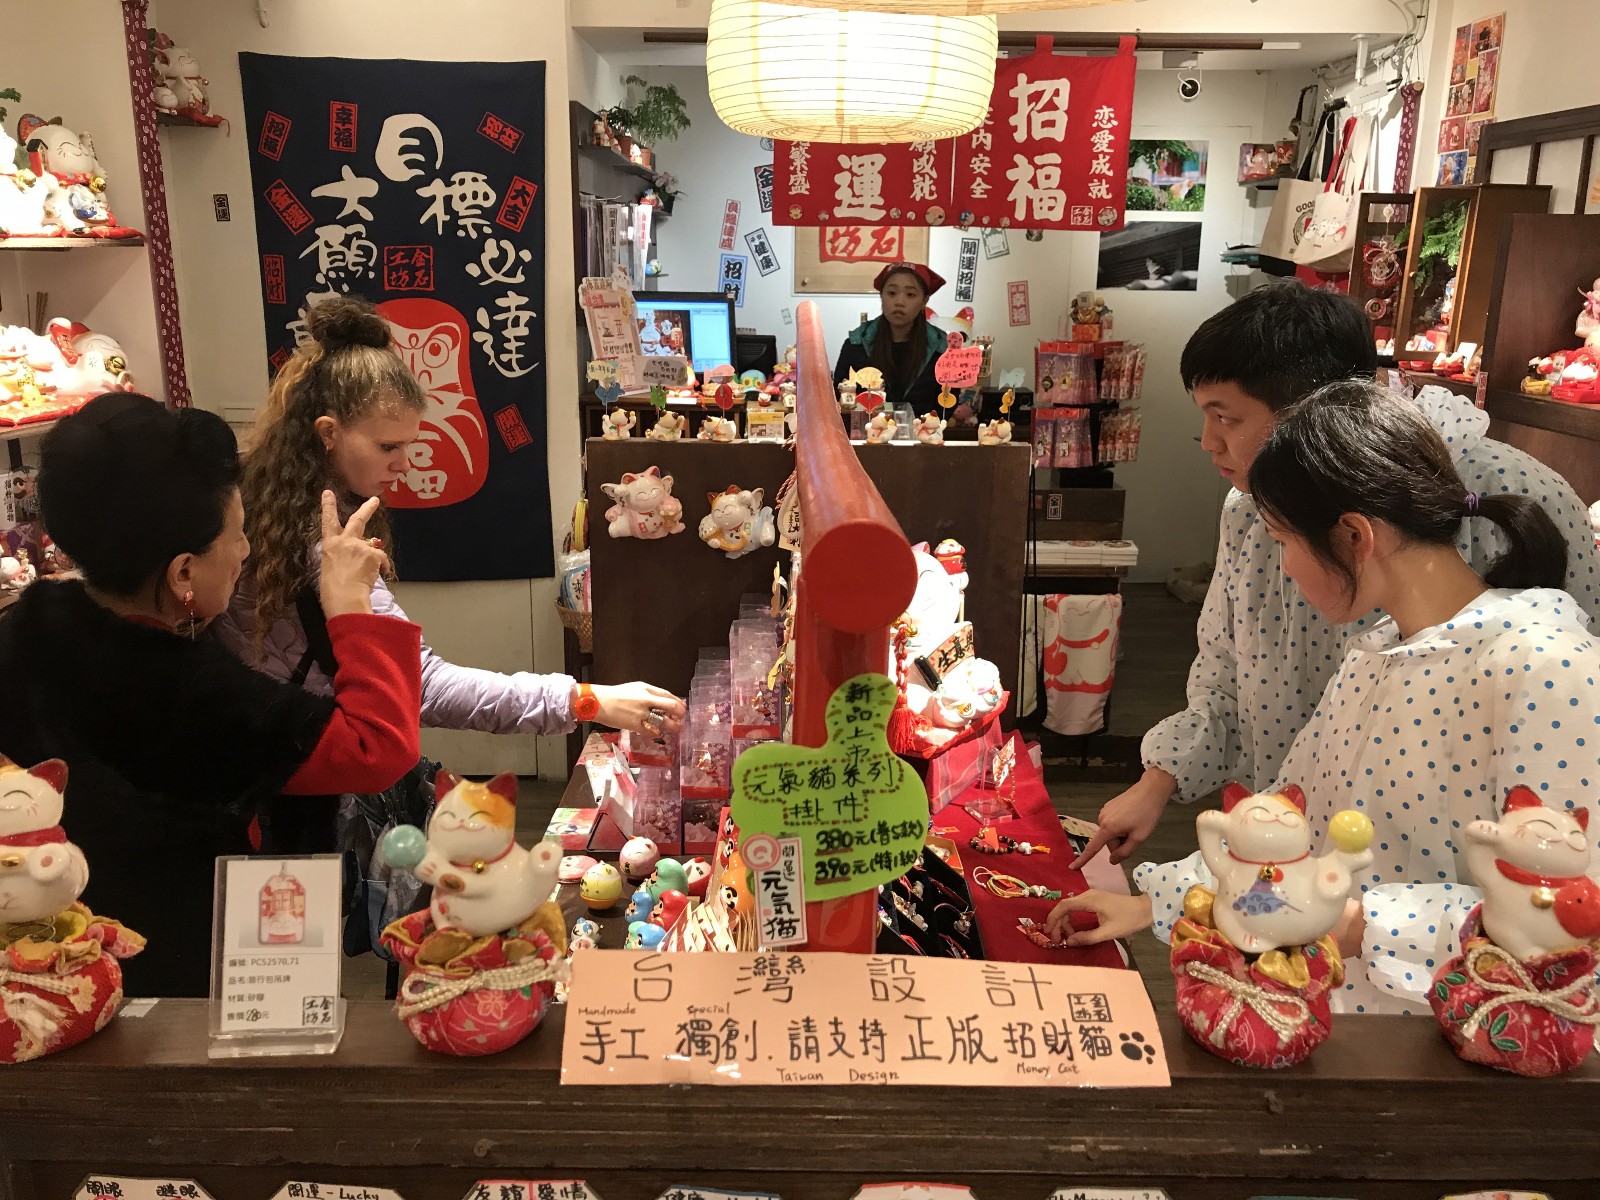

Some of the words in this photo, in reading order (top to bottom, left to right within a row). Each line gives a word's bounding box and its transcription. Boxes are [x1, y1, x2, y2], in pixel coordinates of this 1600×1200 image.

[263, 118, 286, 155] 招福
[334, 106, 354, 148] 幸福
[1006, 73, 1071, 222] 招福
[1088, 105, 1118, 199] 恋愛成就
[504, 185, 531, 225] 大吉
[754, 241, 774, 270] 健康
[957, 241, 977, 300] 開運招福
[845, 683, 874, 767] 新品上市
[789, 792, 863, 821] 掛件
[578, 1005, 637, 1016] Handmade
[776, 1068, 824, 1082] Taiwan
[848, 1068, 900, 1085] Design
[1017, 1063, 1050, 1077] Money
[1058, 1063, 1081, 1075] Cat
